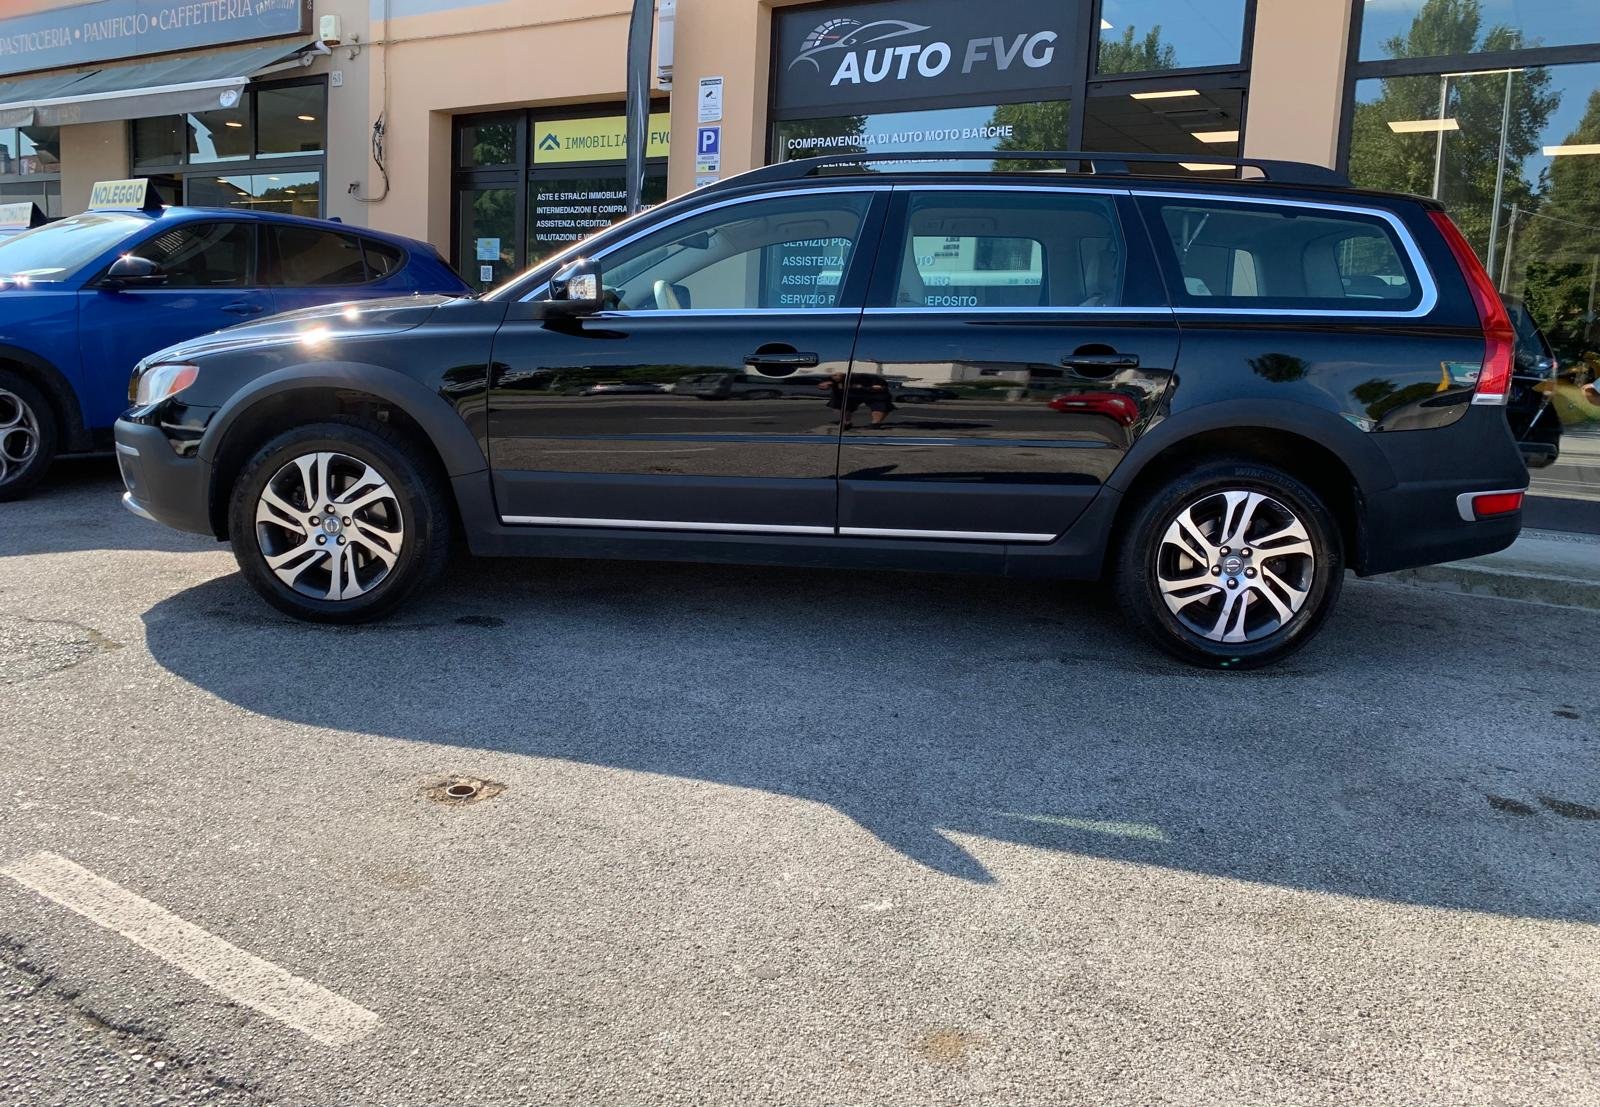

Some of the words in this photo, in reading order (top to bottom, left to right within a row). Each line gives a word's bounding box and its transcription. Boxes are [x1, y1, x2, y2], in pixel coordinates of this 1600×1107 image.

[0, 27, 72, 55] PASTICCERIA
[84, 13, 149, 42] PANIFICIO
[159, 0, 253, 30] CAFFETTERIA
[829, 42, 952, 86] AUTO
[961, 30, 1058, 74] FVG
[702, 131, 716, 152] P
[787, 134, 875, 150] COMPRAVENDITA
[878, 134, 889, 144] DI
[891, 131, 922, 143] AUTO
[925, 128, 960, 141] MOTO
[962, 125, 1014, 139] BARCHE
[92, 184, 144, 204] NOLEGGIO
[537, 193, 553, 201] ASTE
[555, 192, 559, 200] E
[560, 192, 587, 200] STRALCI
[536, 206, 591, 214] INTERMEDIAZIONI
[593, 205, 597, 213] E
[536, 220, 575, 228] ASSISTENZA
[576, 219, 612, 227] CREDITIZIA
[536, 233, 576, 241] VALUTAZIONI
[782, 256, 845, 266] ASSISTENZA
[781, 275, 840, 285] ASSISTENZ
[780, 294, 825, 304] SERVIZIO
[924, 295, 977, 306] EPOSITO
